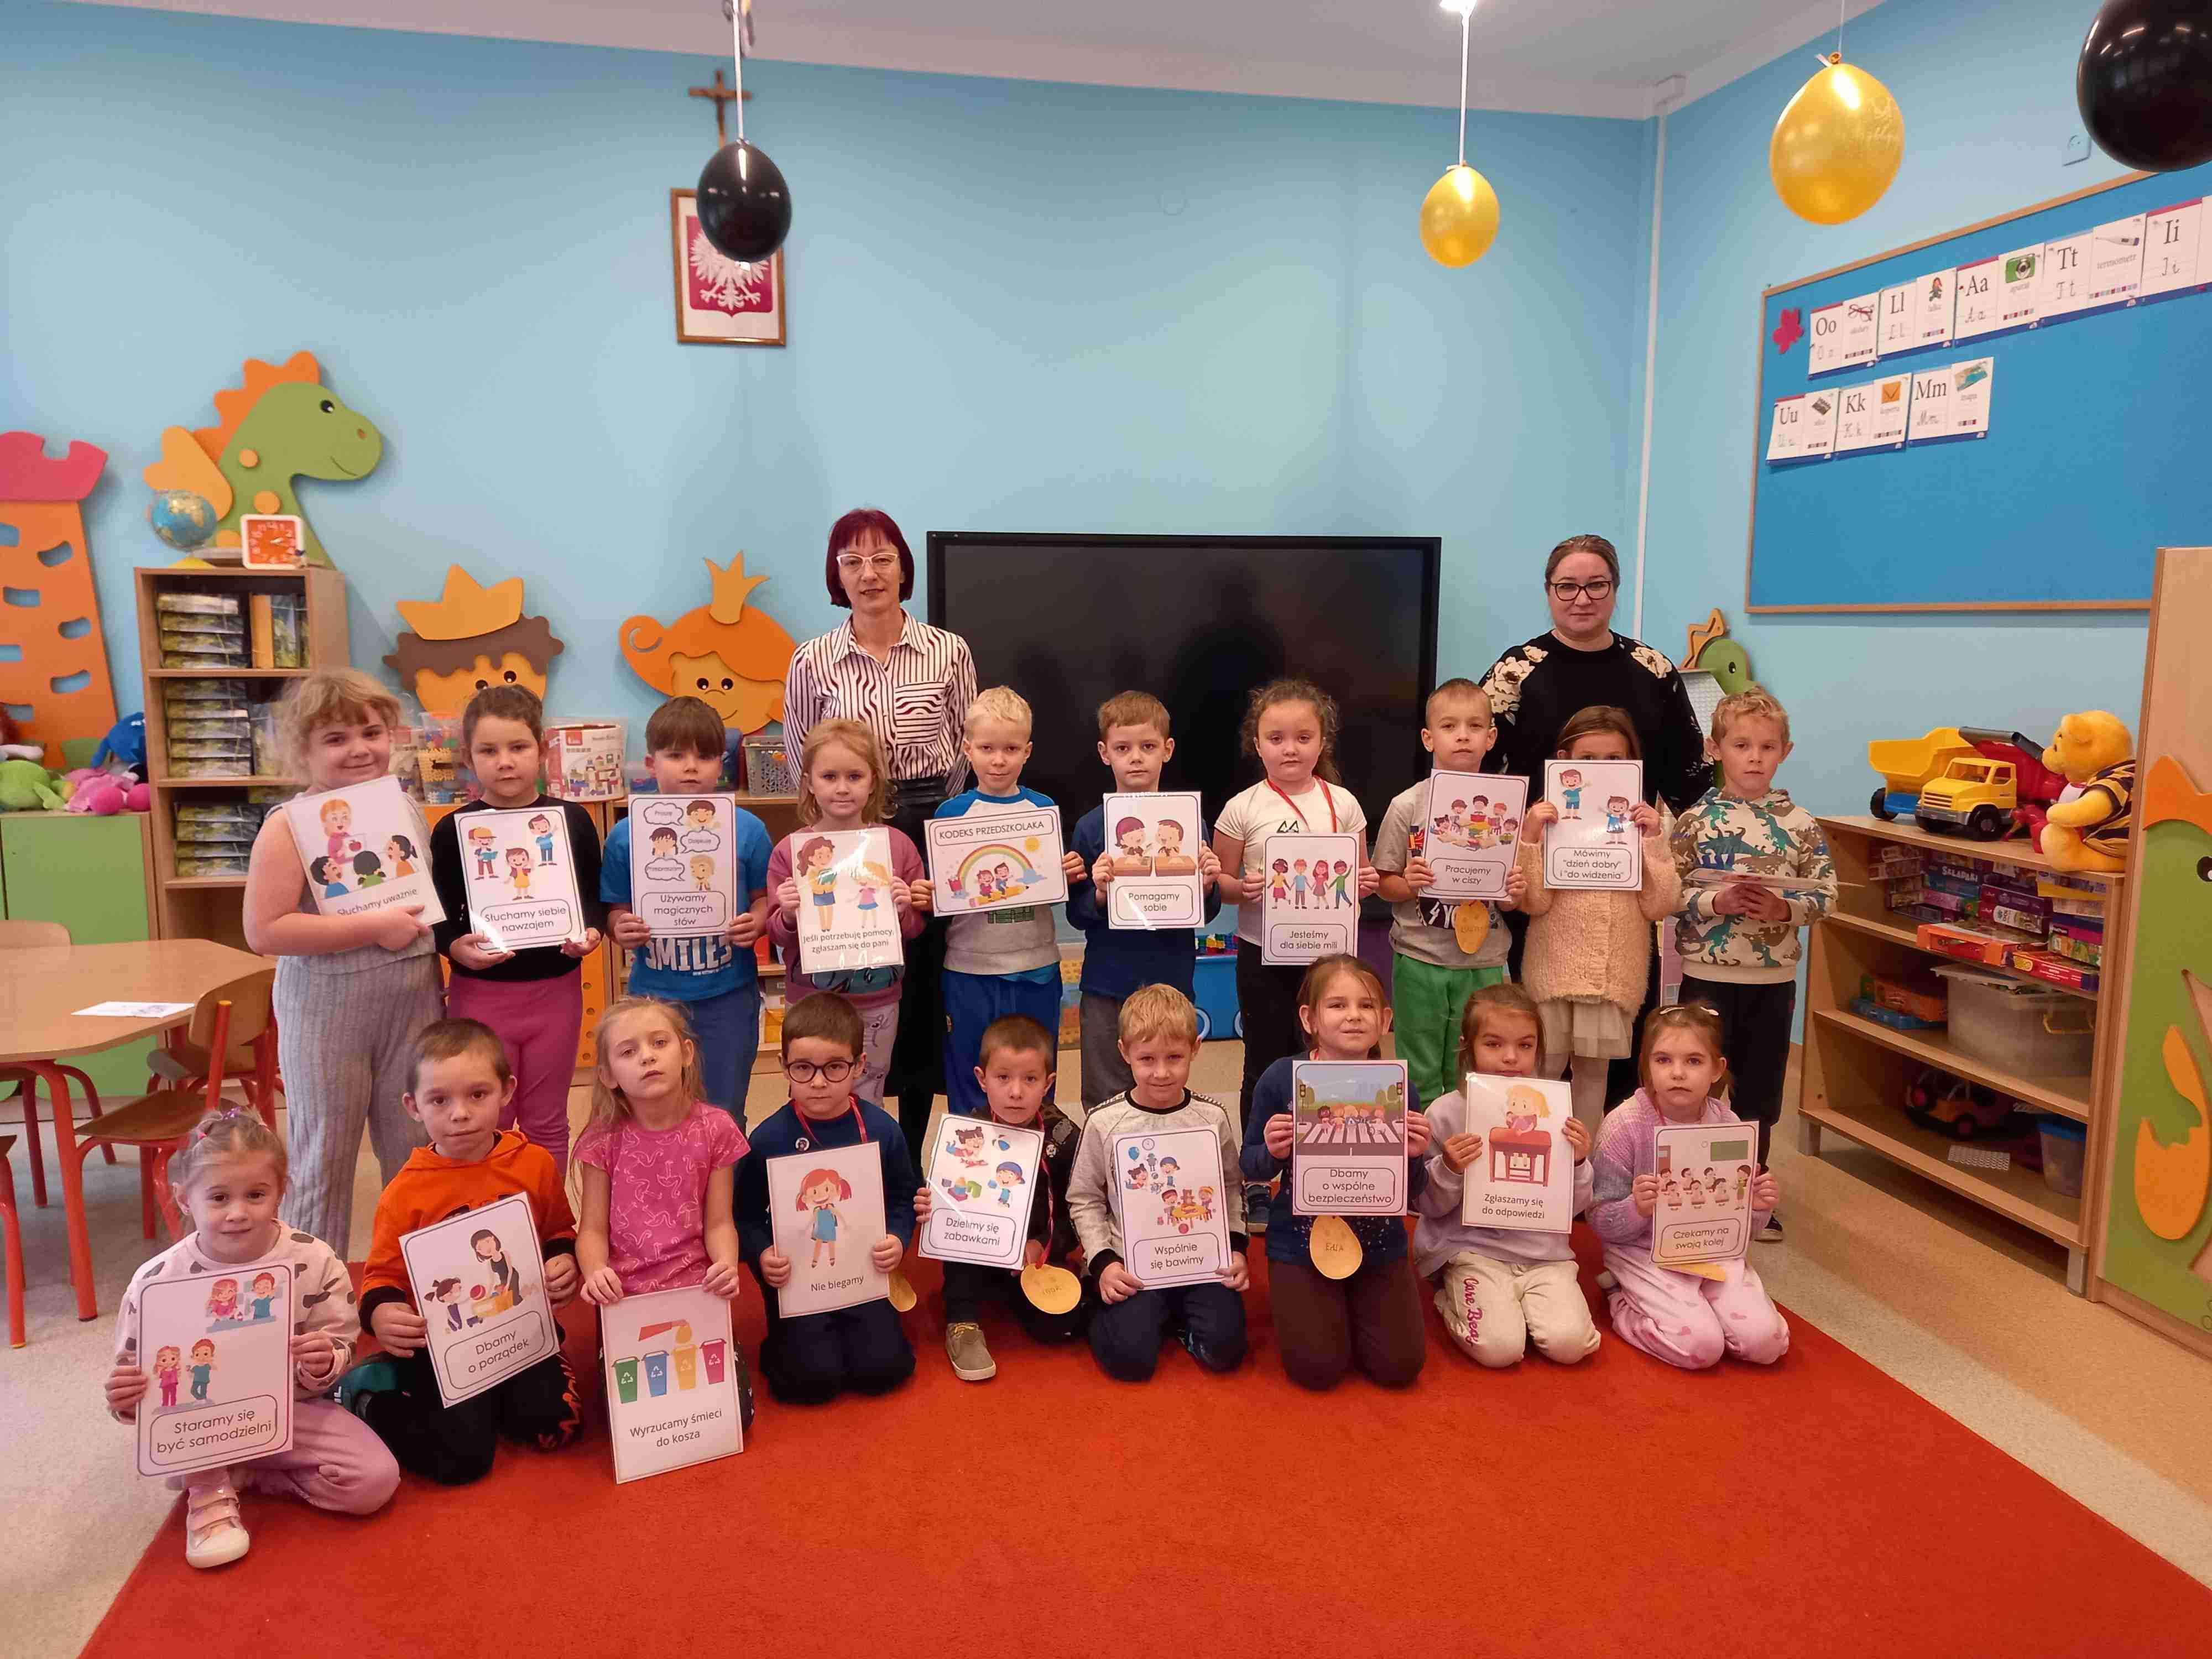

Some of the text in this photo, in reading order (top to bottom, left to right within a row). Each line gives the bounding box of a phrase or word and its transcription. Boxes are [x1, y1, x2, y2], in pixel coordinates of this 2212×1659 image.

[2163, 219, 2179, 244] Ii
[2057, 246, 2079, 270] Tt
[1965, 275, 1989, 296] Aa
[1890, 291, 1905, 315] Ll
[1815, 317, 1837, 336] Oo
[1914, 379, 1947, 400] Mm
[1846, 392, 1866, 414] Kk
[1780, 407, 1798, 425] Uu
[940, 820, 1045, 839] KODEKS PRZEDSZKOLAKA
[1573, 849, 1611, 859] Mówimy
[1445, 864, 1491, 877] Pracujemy
[1460, 875, 1481, 886] ciszy
[660, 894, 706, 905] Używamy
[1128, 893, 1180, 902] Pomagamy
[484, 906, 566, 922] Słuchamy siebie
[654, 905, 713, 916] magicznych
[1144, 904, 1167, 912] sobie
[502, 920, 555, 932] nawzajem
[674, 917, 696, 926] słów
[803, 934, 818, 943] Jeśli
[820, 932, 862, 942] potrzebuję
[1289, 930, 1329, 941] Jesteśmy
[872, 939, 889, 948] pani
[1280, 941, 1338, 950] dla siebie mili
[1330, 1169, 1368, 1180] Dbamy
[1331, 1181, 1375, 1192] wspólne
[1308, 1193, 1392, 1205] bezpieczeństwo
[1531, 1198, 1543, 1208] się
[1482, 1206, 1545, 1219] do odpowiedzi
[945, 1217, 999, 1234] Dzielimy się
[943, 1230, 1000, 1246] zabawkami
[1673, 1227, 1715, 1241] Czekamy
[1154, 1243, 1198, 1255] Wspólnie
[1675, 1237, 1724, 1251] swoją kolej
[1150, 1255, 1204, 1271] się bawimy
[811, 1275, 864, 1293] Nie biegamy
[1463, 1277, 1479, 1306] Care
[475, 1330, 517, 1355] Dbamy
[468, 1338, 529, 1373] o porządek
[174, 1409, 255, 1434] Staramy się
[629, 1408, 723, 1439] Wyrzucamy śmieci
[156, 1420, 272, 1454] być samodzielni
[656, 1431, 701, 1448] do kosza
